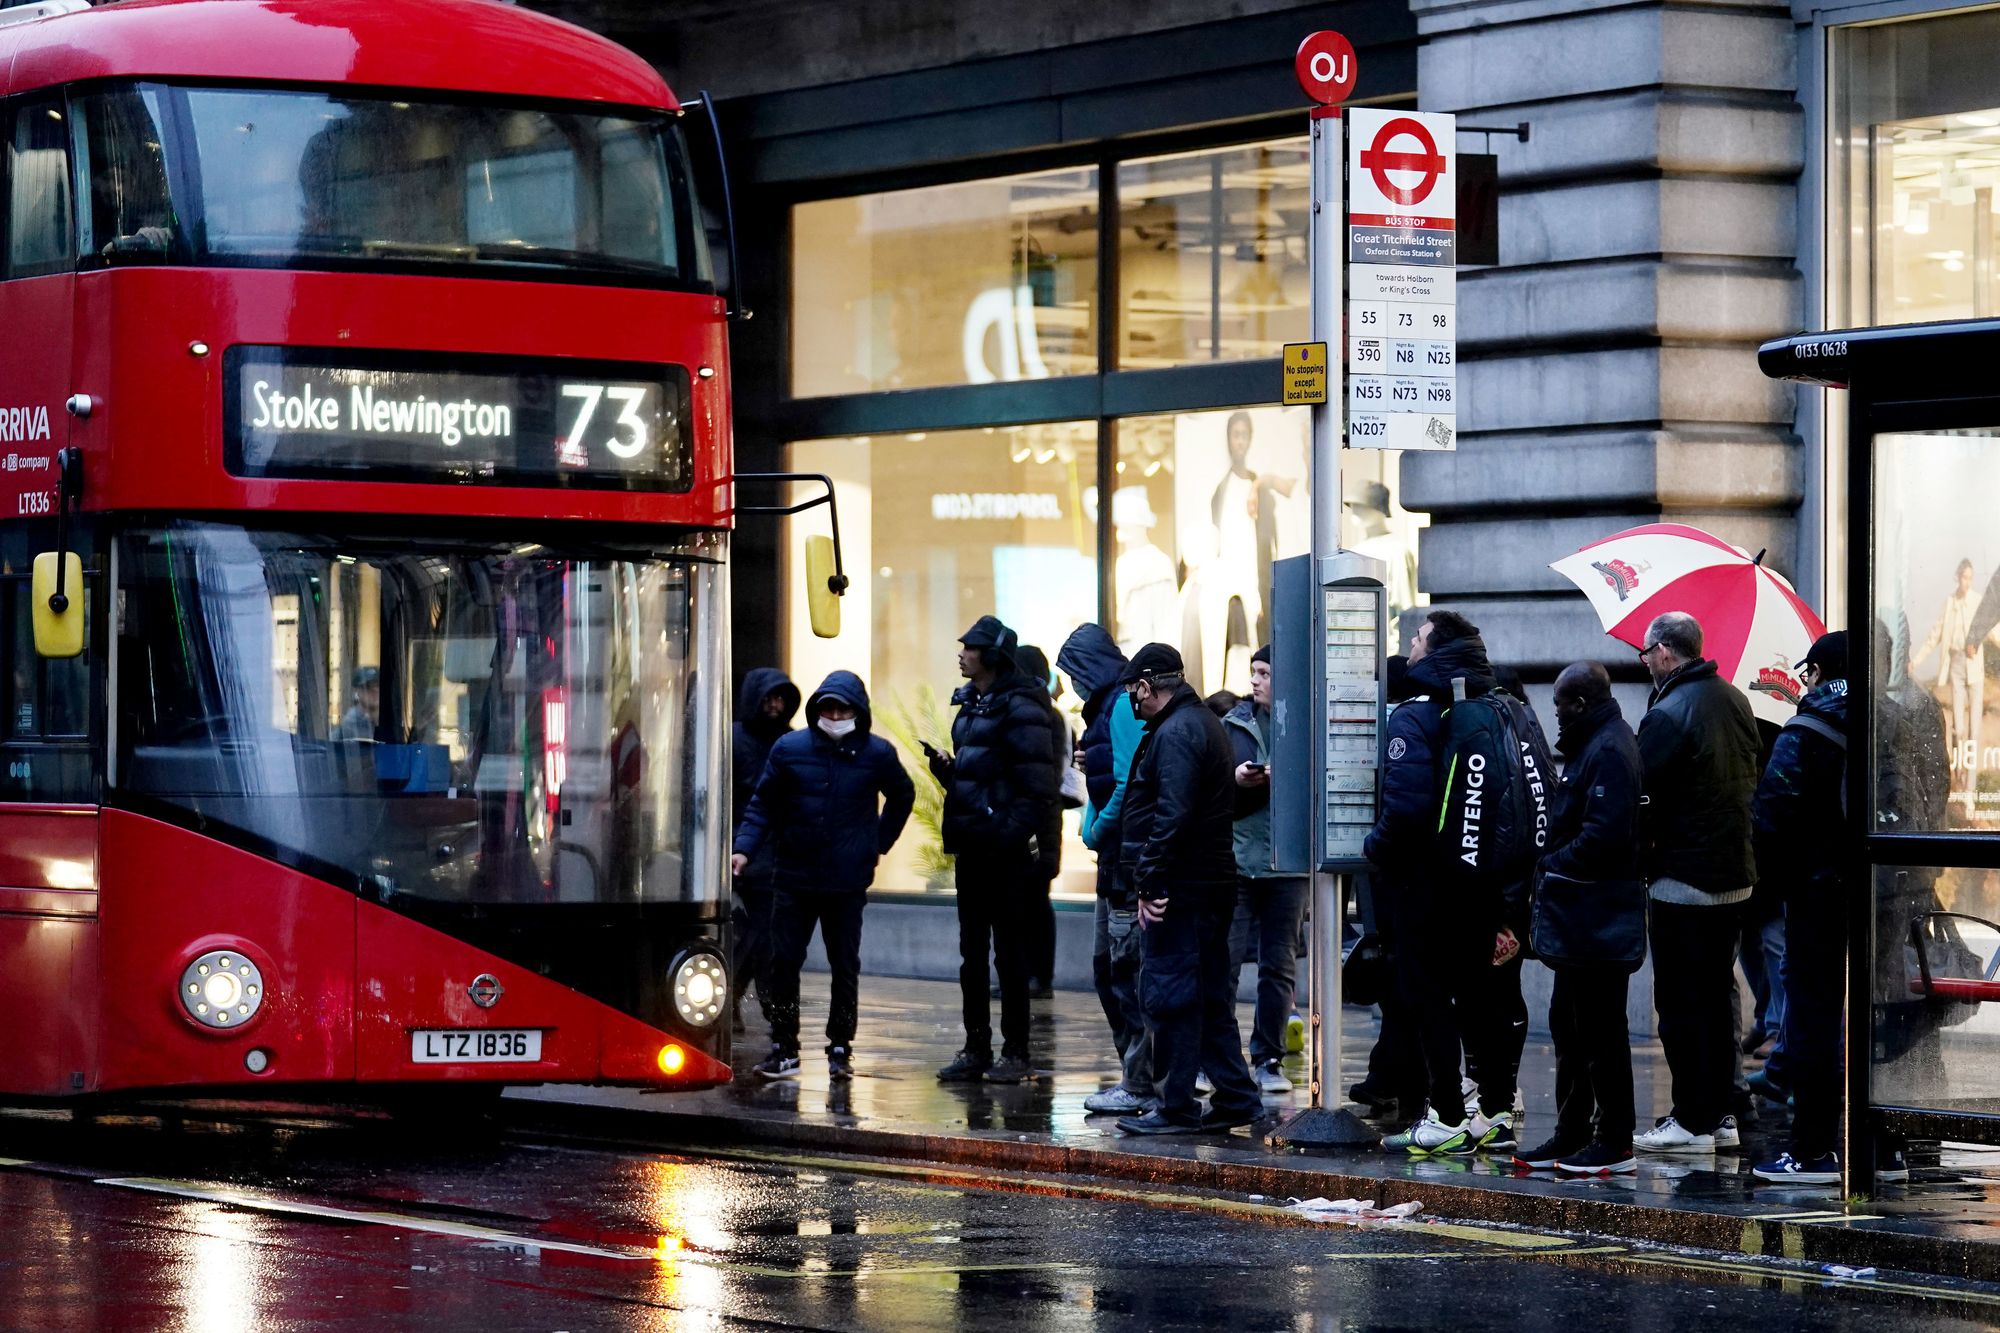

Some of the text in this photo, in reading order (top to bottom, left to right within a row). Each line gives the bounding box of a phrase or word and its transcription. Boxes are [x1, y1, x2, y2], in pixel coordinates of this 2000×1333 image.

[1310, 52, 1349, 84] OJ
[1385, 217, 1426, 227] BUS STOP
[1354, 233, 1452, 247] Great Titchfield Street
[1365, 248, 1434, 258] Oxford Circus Station
[1376, 274, 1434, 284] towards Holborn
[1389, 285, 1410, 296] King's
[1412, 286, 1431, 295] Cross
[1361, 311, 1377, 324] 55
[1398, 313, 1413, 326] 73
[1433, 315, 1447, 328] 98
[1357, 348, 1381, 361] 390
[1396, 350, 1414, 363] N8
[1795, 341, 1848, 359] 0133 0628
[1428, 351, 1451, 364] N25
[1286, 364, 1324, 375] No stopping
[1295, 378, 1315, 388] except
[1287, 390, 1322, 399] local buses
[1356, 386, 1382, 399] N55
[1393, 387, 1418, 401] N73
[1428, 388, 1452, 402] N98
[253, 381, 511, 446] Stoke Newington
[562, 385, 648, 458] 73
[1352, 422, 1386, 436] N207
[2, 458, 6, 469] a
[19, 456, 50, 472] company
[19, 491, 49, 514] LT836
[1521, 741, 1548, 848] ARTENGO
[1460, 753, 1486, 867] ARTENGO
[426, 1033, 527, 1057] LTZ 1836
